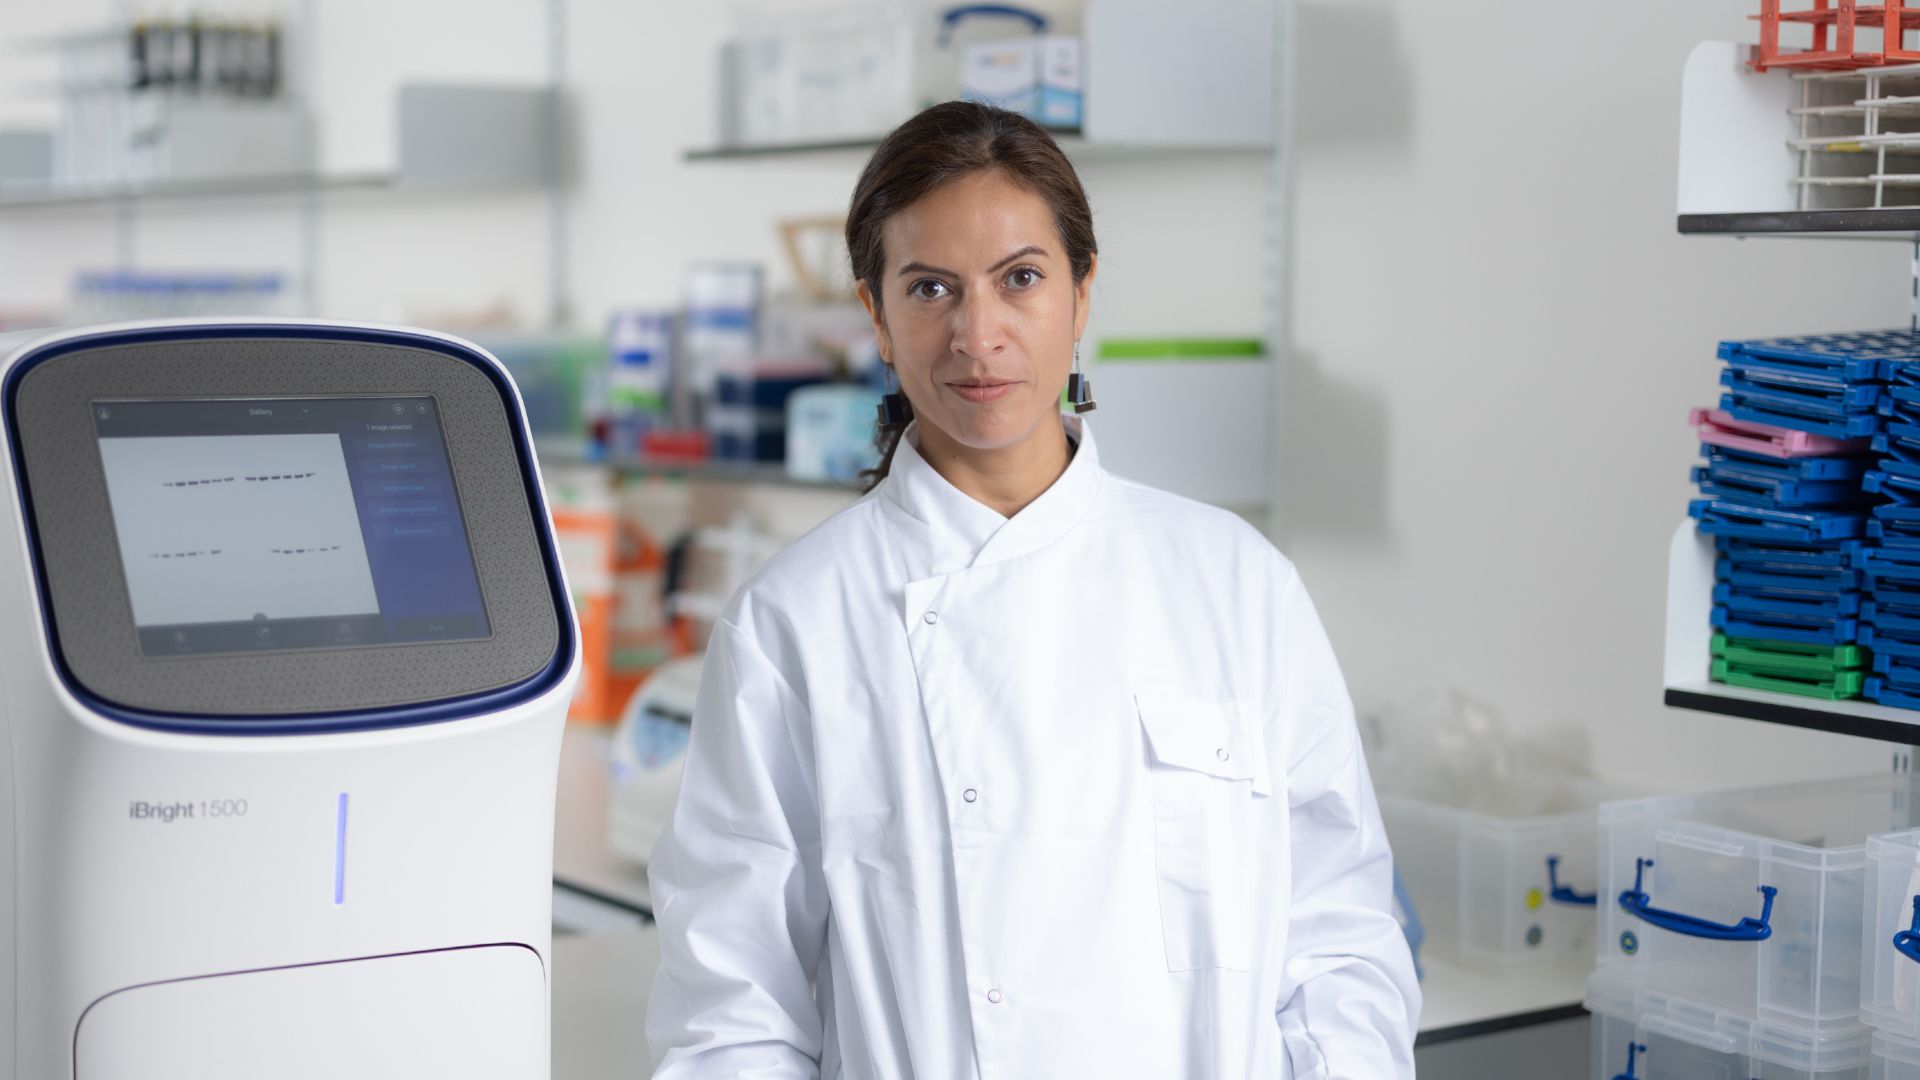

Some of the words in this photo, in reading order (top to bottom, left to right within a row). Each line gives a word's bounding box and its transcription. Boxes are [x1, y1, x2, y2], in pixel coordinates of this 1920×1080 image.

[249, 408, 272, 417] Gallery
[129, 801, 194, 822] iBright
[200, 799, 248, 817] 1500
